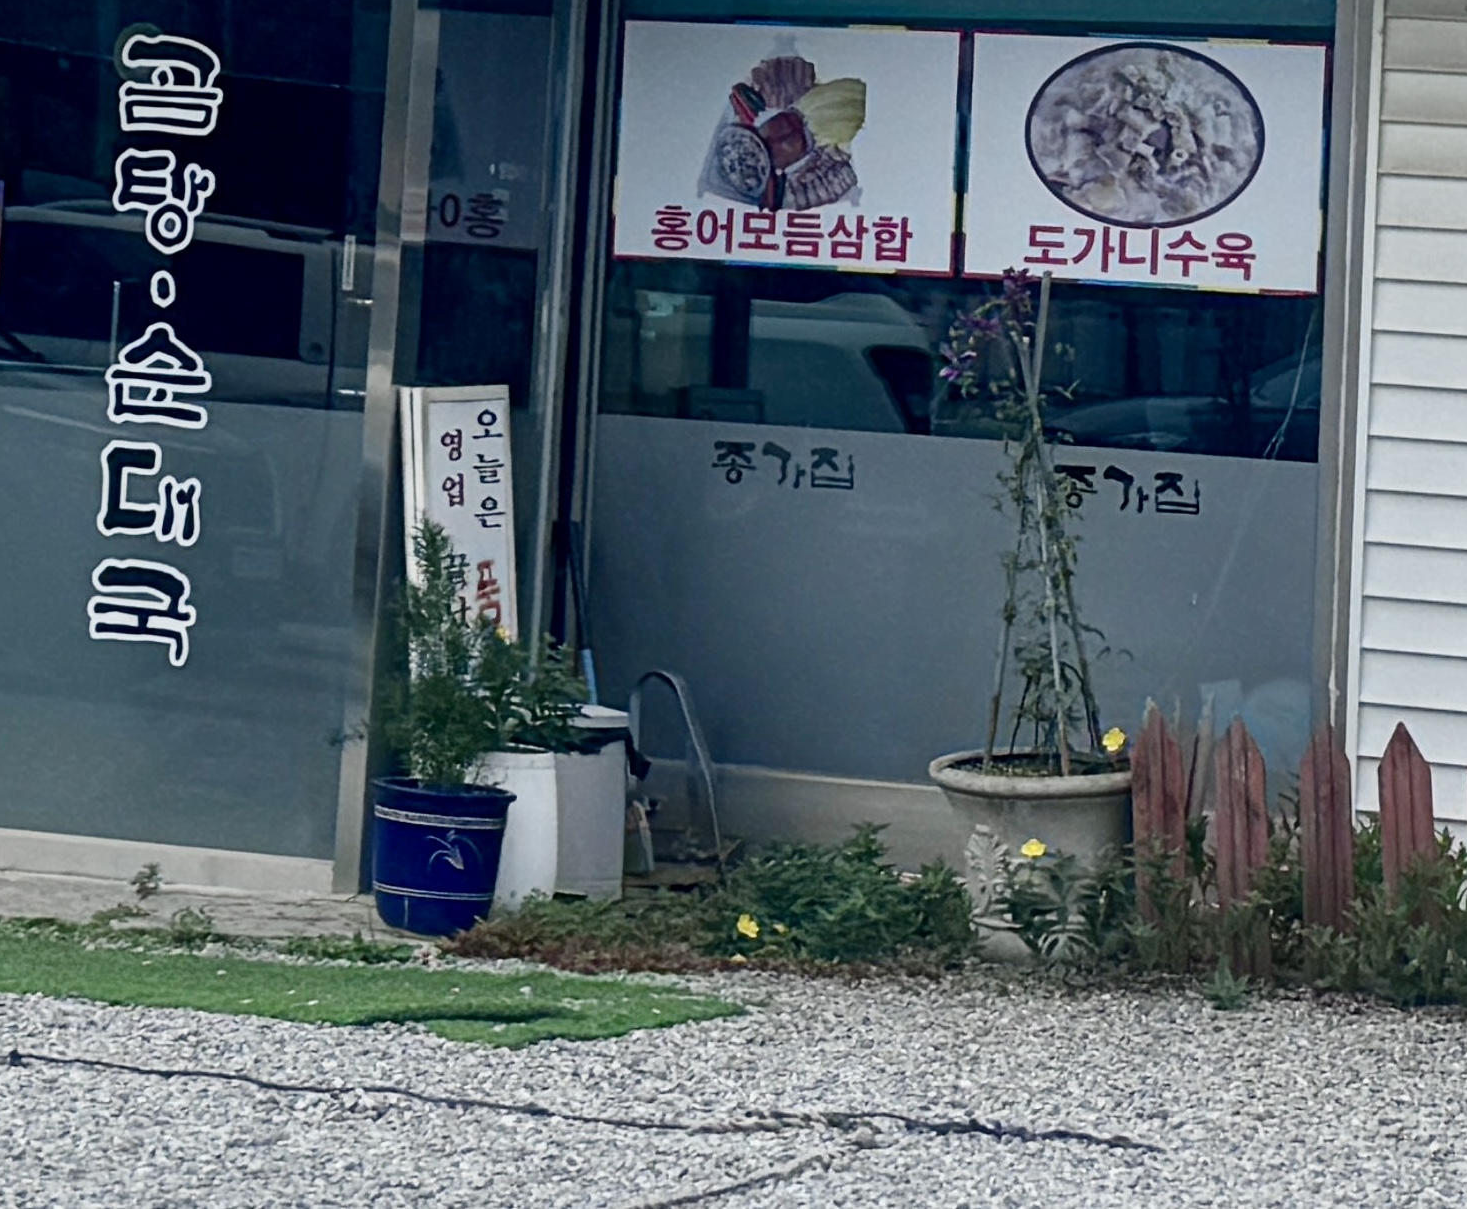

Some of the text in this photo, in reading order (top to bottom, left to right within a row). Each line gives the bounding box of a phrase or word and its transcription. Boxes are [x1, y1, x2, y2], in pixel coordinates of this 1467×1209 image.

[650, 205, 914, 262] 홍어모듬삼합
[1022, 224, 1258, 282] 도가니수육
[440, 428, 464, 508] 영업
[472, 408, 506, 529] 오늘은
[712, 440, 855, 491] 종가집
[1052, 464, 1201, 516] 종가집
